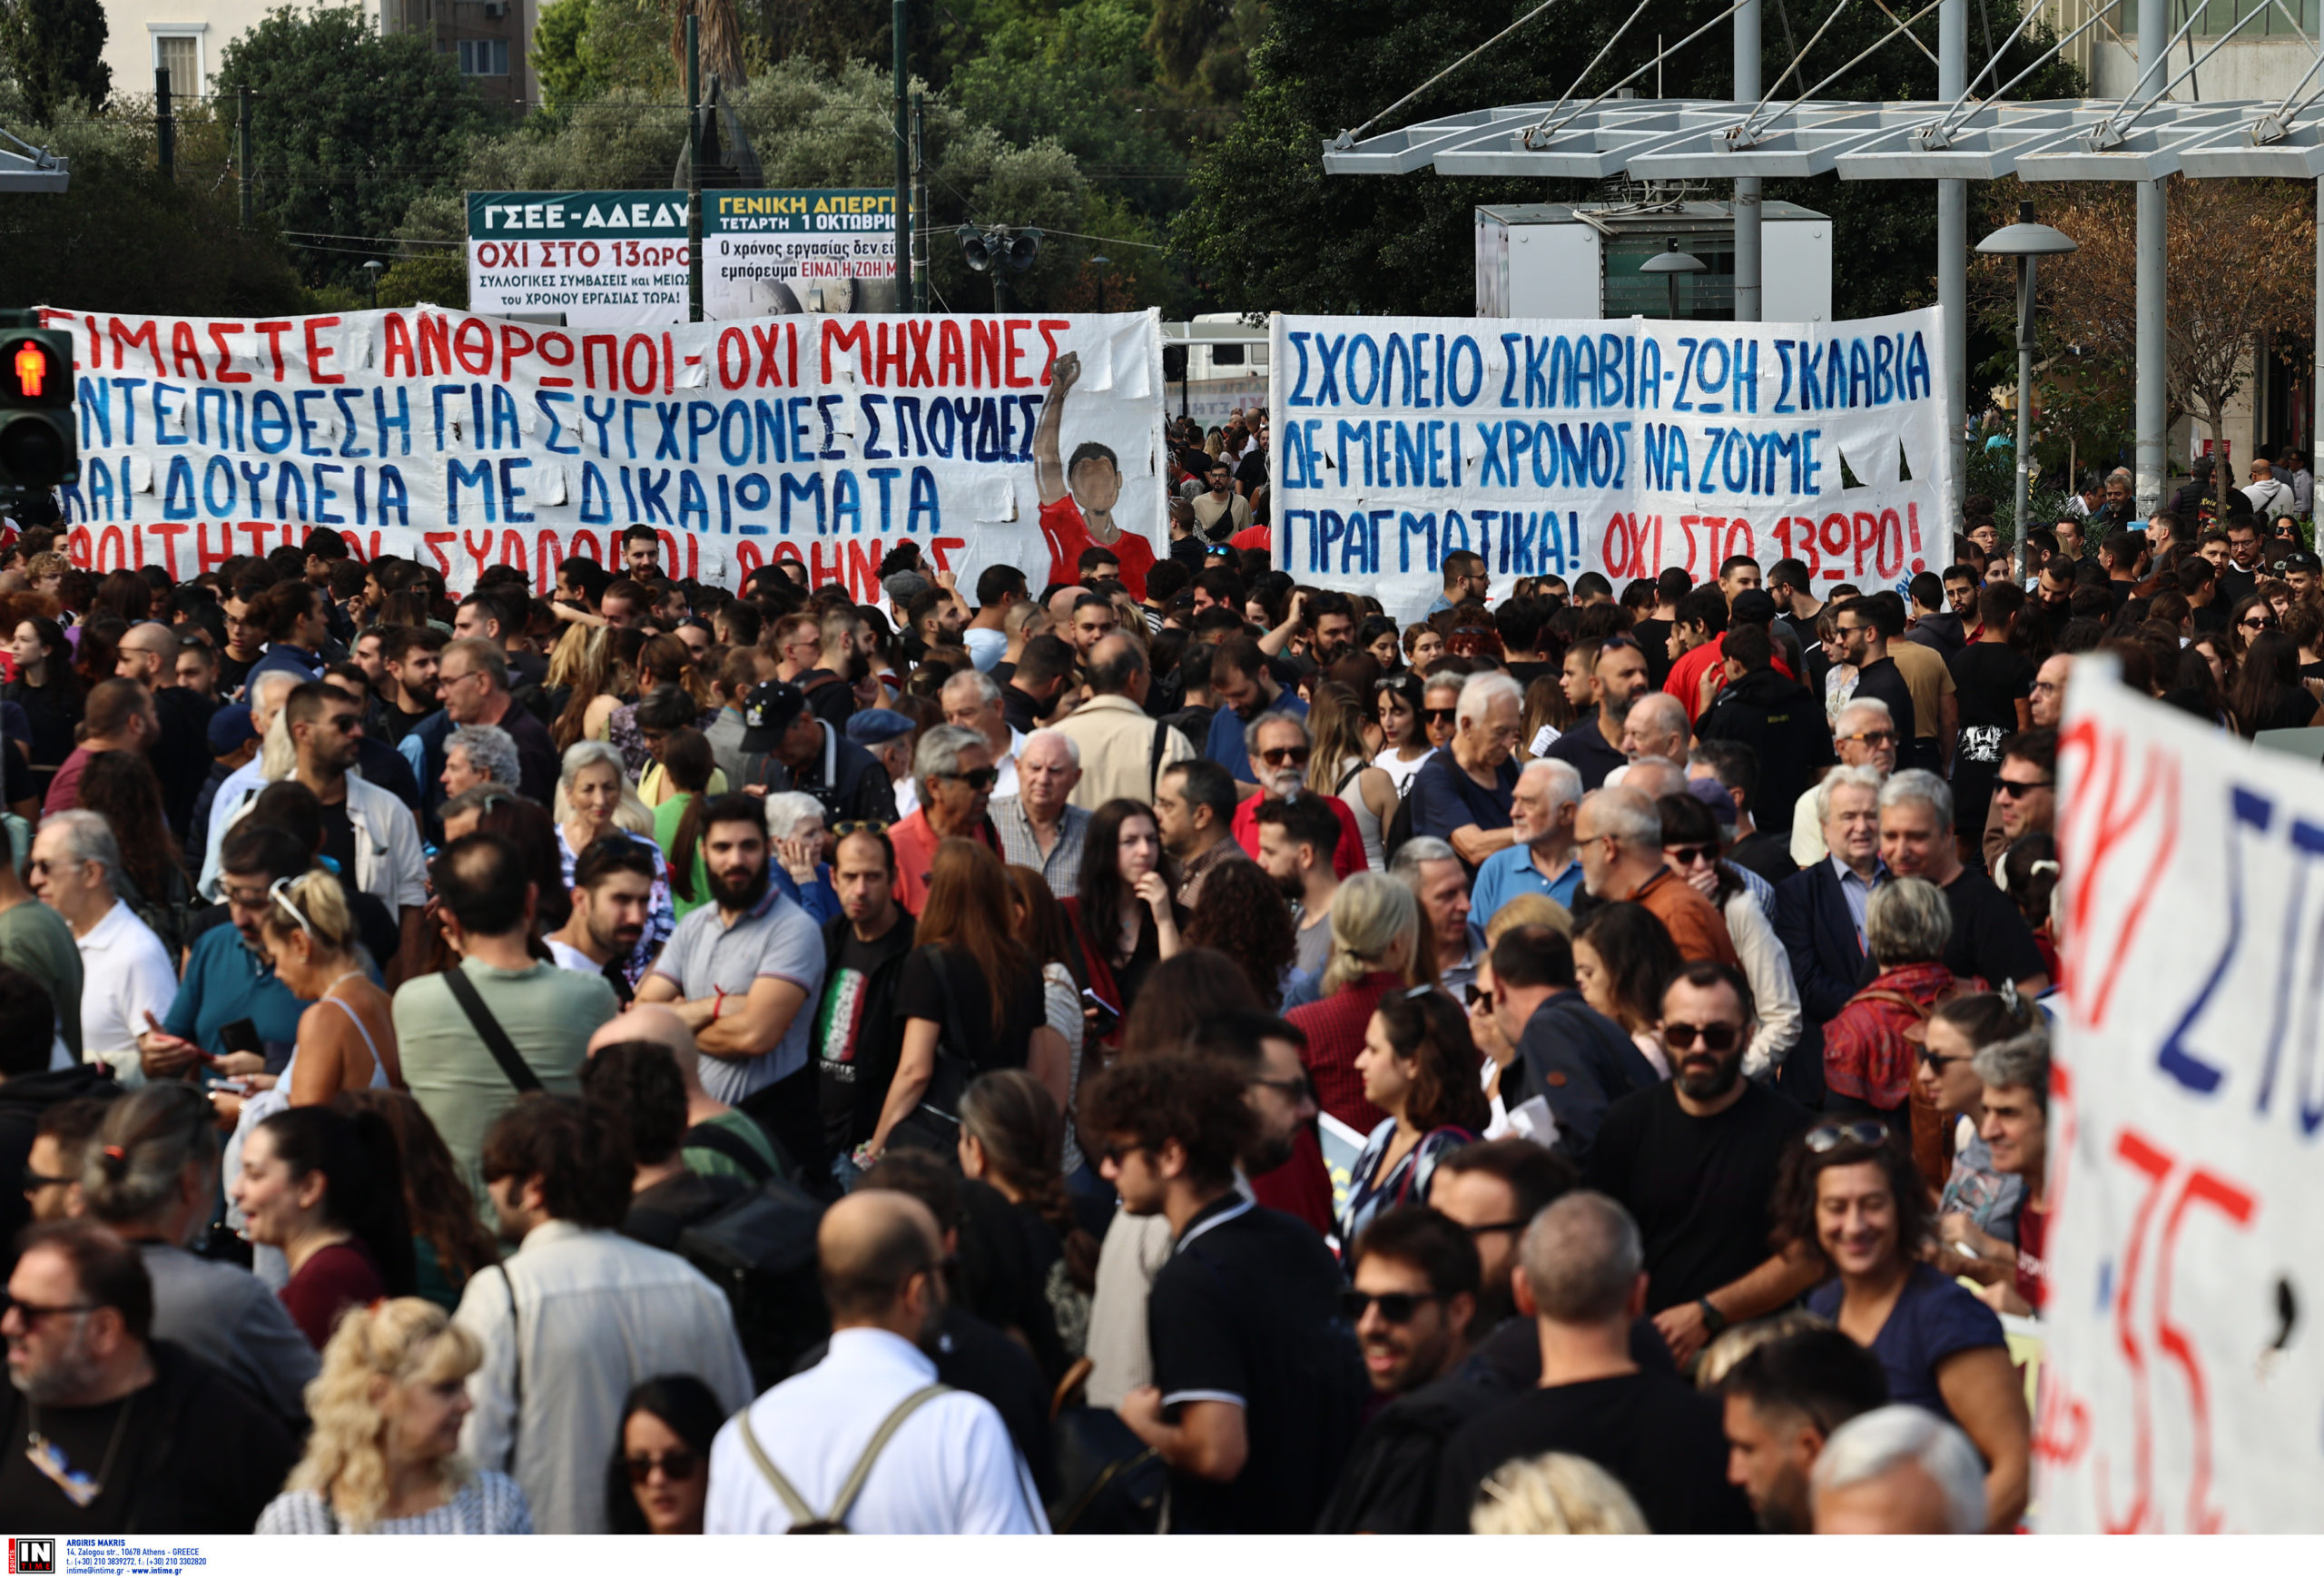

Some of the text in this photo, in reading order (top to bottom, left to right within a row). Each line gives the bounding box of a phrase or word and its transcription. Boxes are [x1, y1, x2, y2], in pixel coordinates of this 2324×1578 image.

[719, 195, 913, 214] ΓΕΝΙΚΗ ΑΠΕΡΓΙ
[720, 213, 913, 230] ΤΕΤΑΡΤΗ 1 ΟΚΤΩΒΡΙ
[477, 242, 528, 268] ΟΧΙ
[540, 241, 601, 268] ΣΤΟ
[721, 241, 729, 255] Ο
[734, 240, 782, 259] χρόνος
[786, 240, 850, 259] εργασίας
[853, 240, 878, 255] δεν
[479, 274, 690, 288] ΣΥΛΛΟΓΙΚΕΣ ΣΥΜΒΑΣΕΙΣ και ΜΕΙΩΣ
[721, 264, 798, 281] εμπόρευμα
[802, 261, 838, 277] ΕΙΝΑΙ
[842, 261, 851, 277] Η
[855, 261, 881, 277] ΖΩΗ
[501, 292, 681, 306] του ΧΡΟΝΟΥ ΕΡΓΑΣΙΑΣ ΤΩΡΑ!
[717, 321, 799, 391] ΟΧΙ
[821, 318, 1071, 390] ΜΗΧΑΝΕΣ
[1287, 331, 1483, 408] ΣΧΟΛΕΙΟ
[1772, 330, 1931, 415] ΣΚΛΑΒΙΑ
[78, 376, 1044, 467] ΝΤΕΠΙΘΕΣΗ ΓΙΑ ΣΥΓΧΡΟΝΕΣ ΣΠΟΥΔΕΣ
[1282, 419, 1822, 497] ΔΕ ΜΕΝΕΙ ΧΡΟΝΟΣ ΝΑ ΖΟΥΜΕ
[162, 454, 410, 527] ΔΟΥΛΕΙΑ
[447, 457, 536, 526] ΜΕ
[579, 459, 941, 536] ΔΙΚΑΙΩΜΑΤΑ
[1282, 508, 1581, 576] ΠΡΑΓΜΑΤΙΚΑ!
[1601, 509, 1662, 582] ΟΧΙ
[1770, 500, 1926, 582] 13ΩΡΟ!
